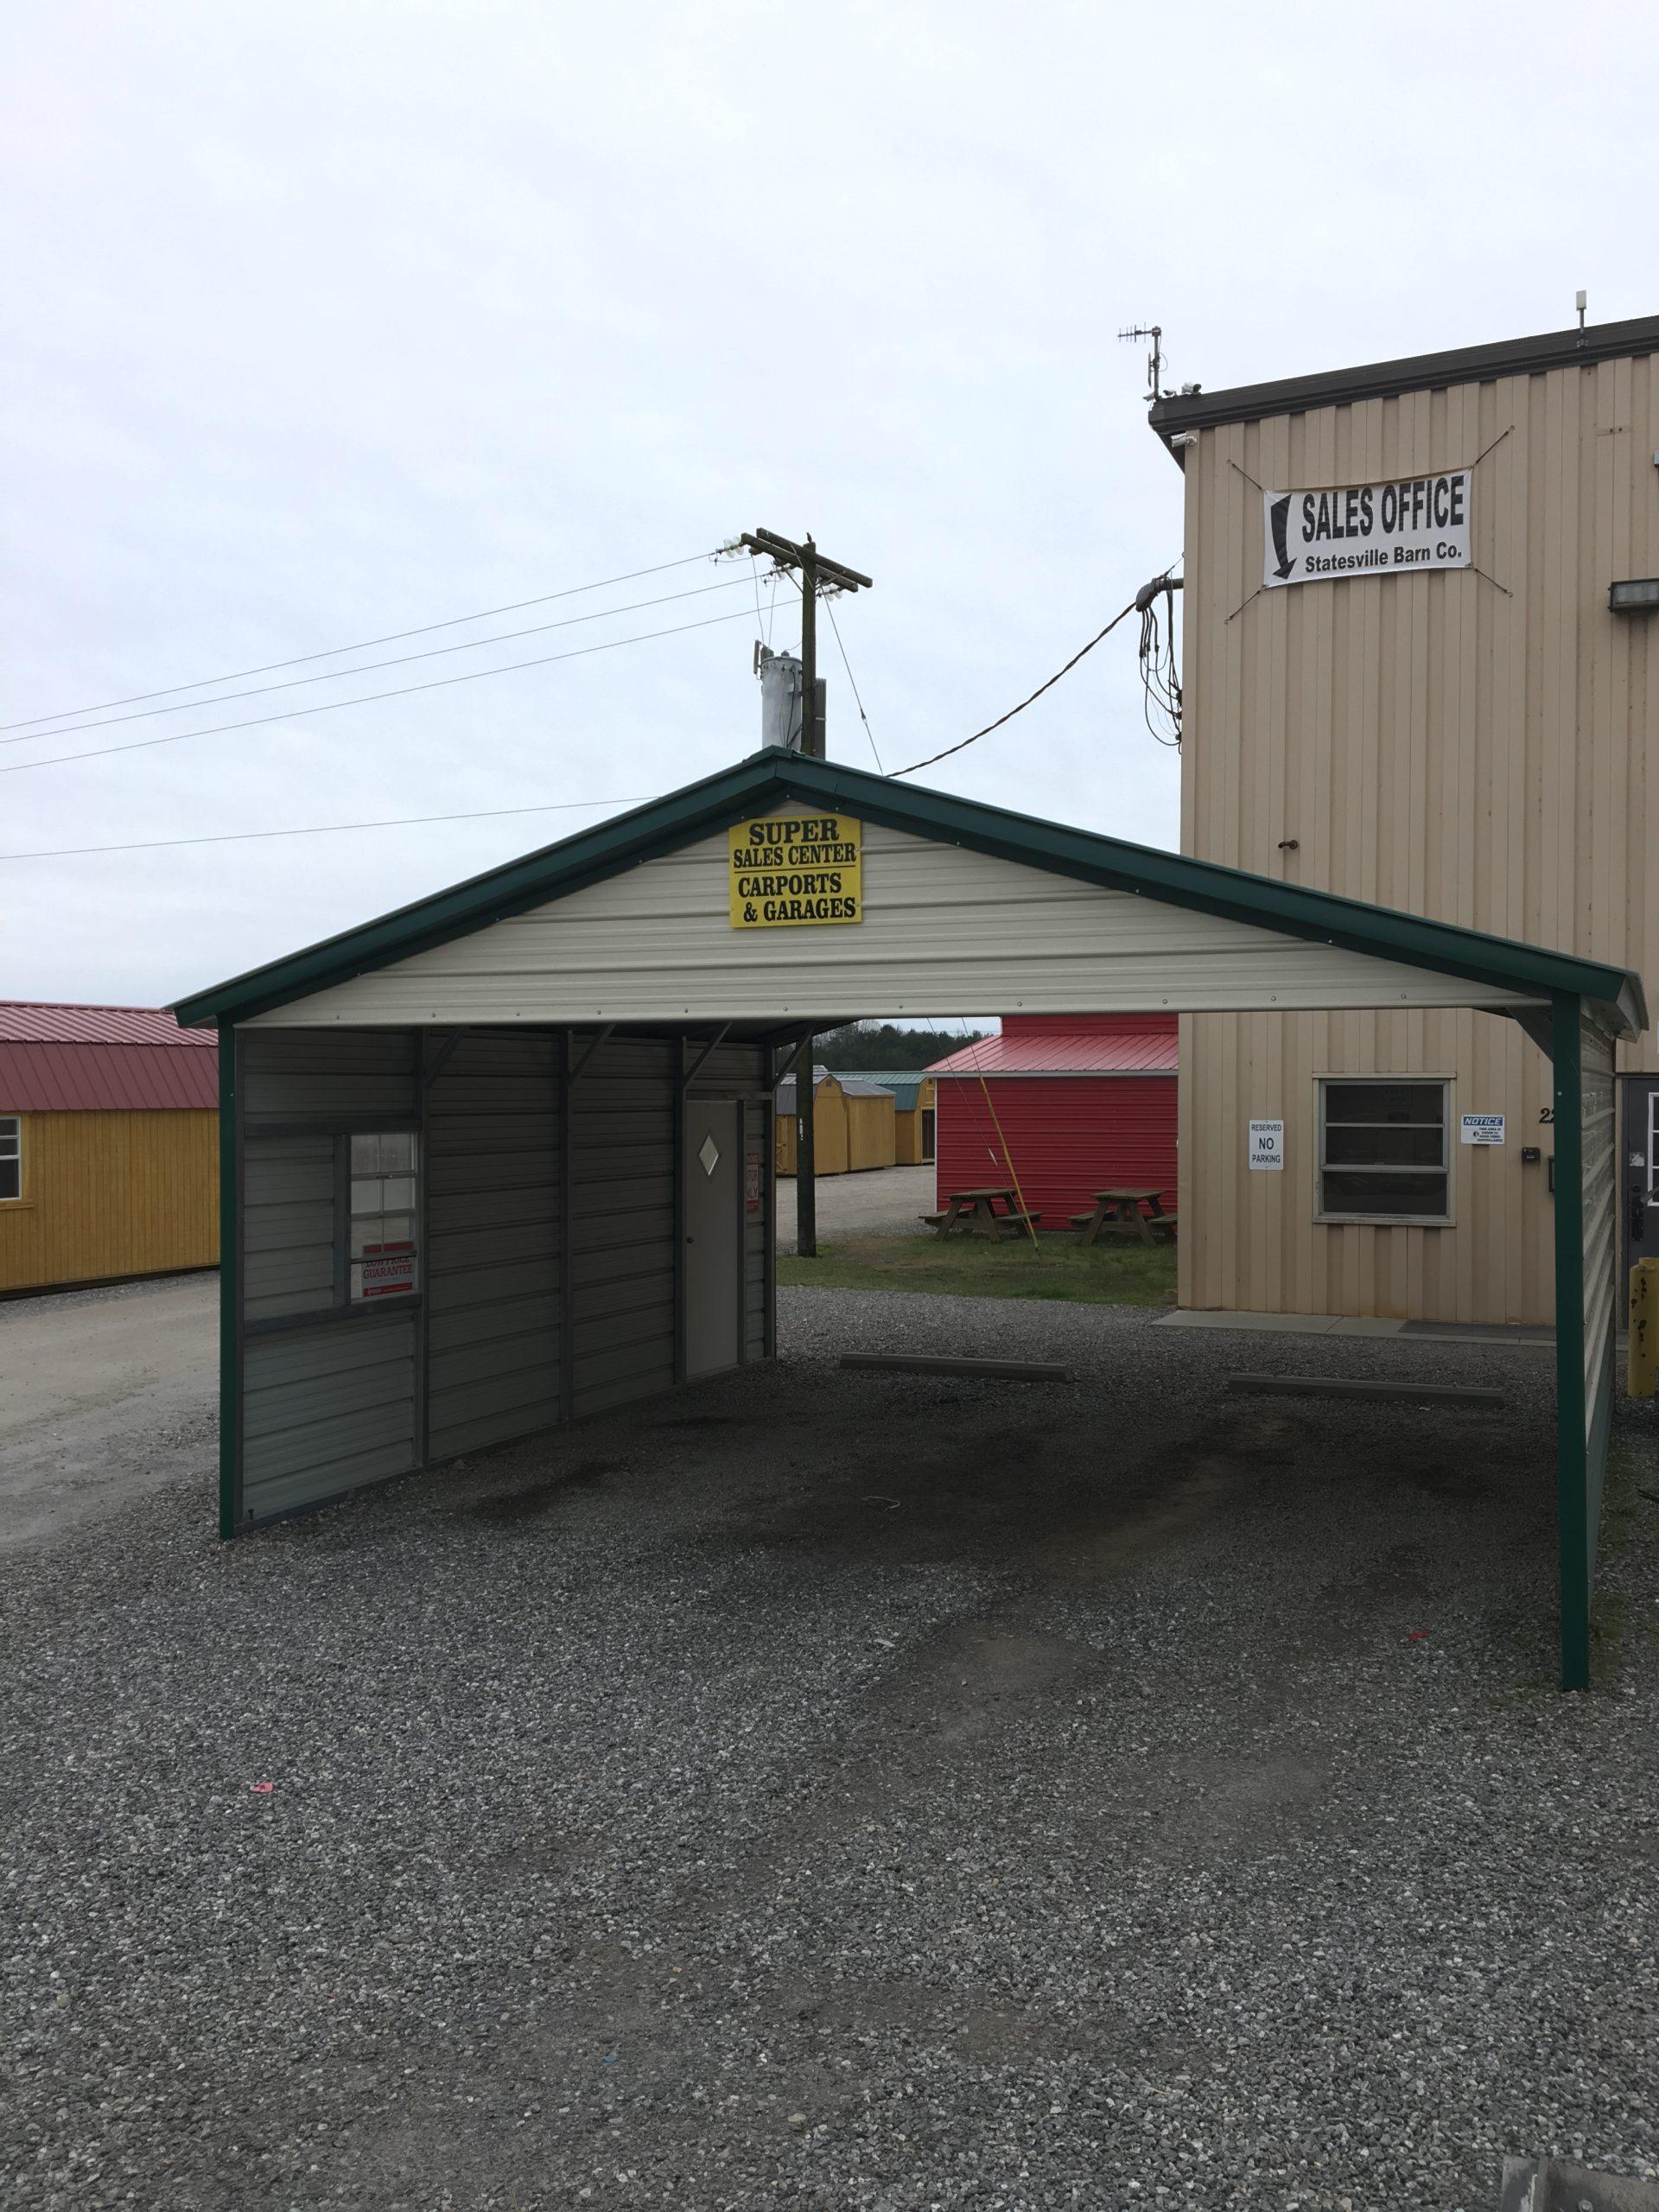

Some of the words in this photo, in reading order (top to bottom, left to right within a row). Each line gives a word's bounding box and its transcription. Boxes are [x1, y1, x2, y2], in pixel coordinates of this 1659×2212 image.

[1302, 486, 1374, 543] SALES
[1382, 475, 1465, 534] OFFICE
[1306, 548, 1389, 573] Statesville
[1394, 546, 1431, 563] Barn
[1436, 542, 1462, 559] Co.
[749, 819, 840, 846] SUPER
[734, 846, 784, 868] SALES
[788, 842, 857, 865] CENTER
[738, 872, 842, 898] CARPORTS
[743, 902, 758, 923] &
[763, 897, 856, 922] GARAGES
[1251, 1123, 1282, 1132] RESERVED
[1258, 1137, 1274, 1150] NO
[1251, 1154, 1281, 1163] PARKING
[363, 1264, 413, 1279] GUARANTEE
